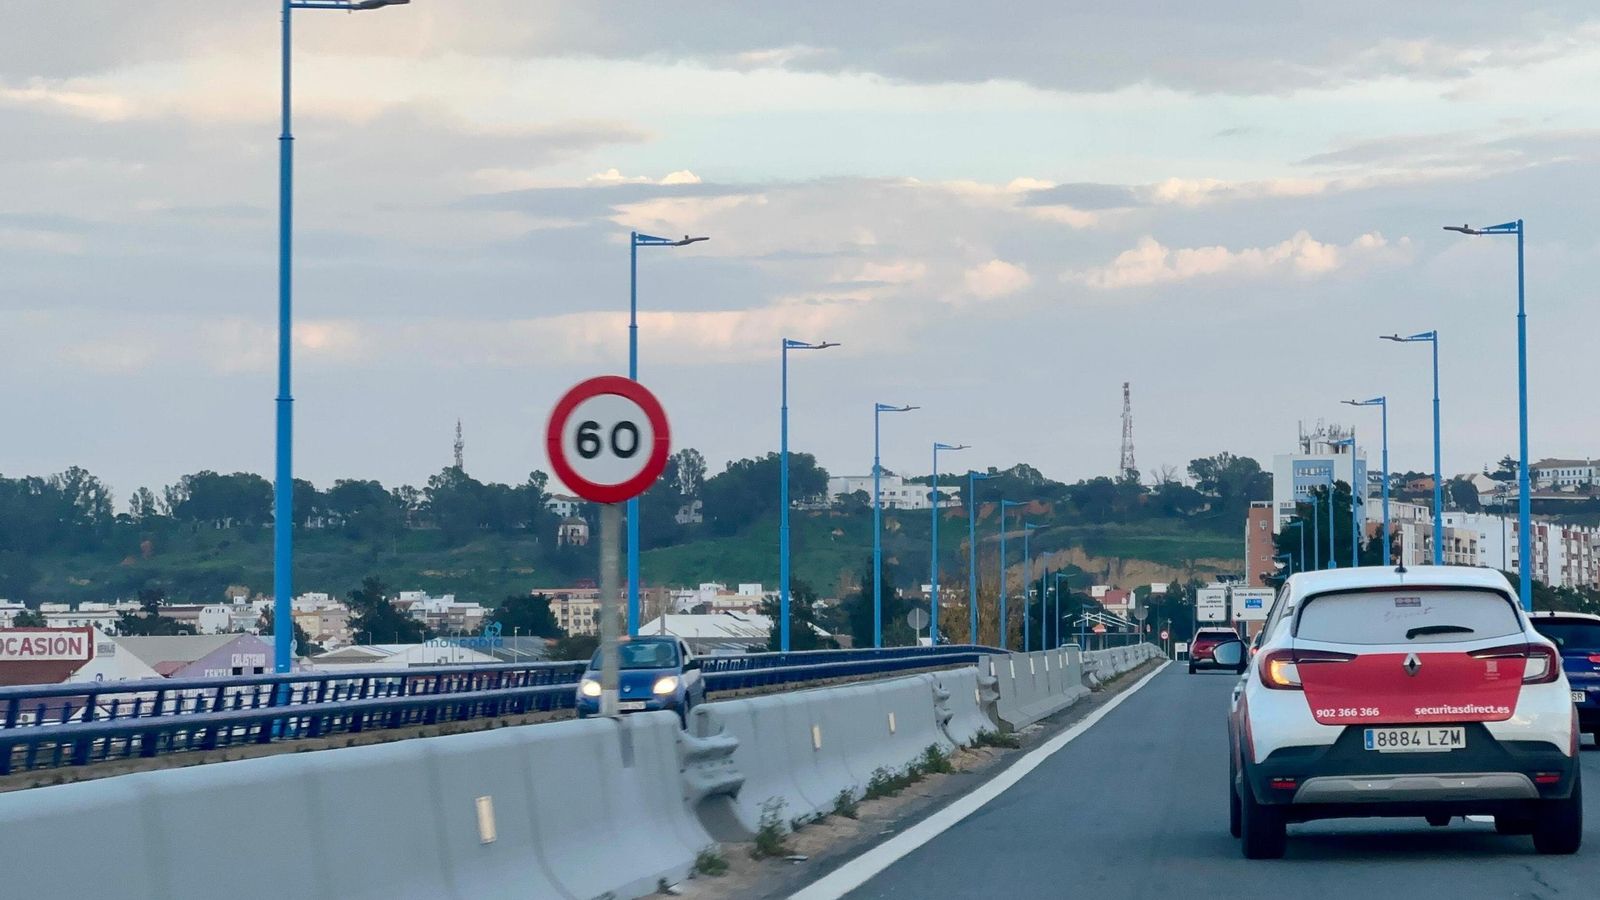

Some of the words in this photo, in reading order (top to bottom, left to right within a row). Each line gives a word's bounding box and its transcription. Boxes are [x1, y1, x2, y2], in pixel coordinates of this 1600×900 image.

[577, 420, 639, 459] 60
[0, 634, 82, 656] CASIÓN
[1571, 692, 1584, 702] SR
[1316, 708, 1335, 718] 902
[1338, 708, 1358, 717] 366
[1359, 707, 1380, 717] 366
[1414, 702, 1510, 716] securitasdirect.es
[1377, 730, 1421, 747] 8884
[1427, 729, 1461, 746] LZM
